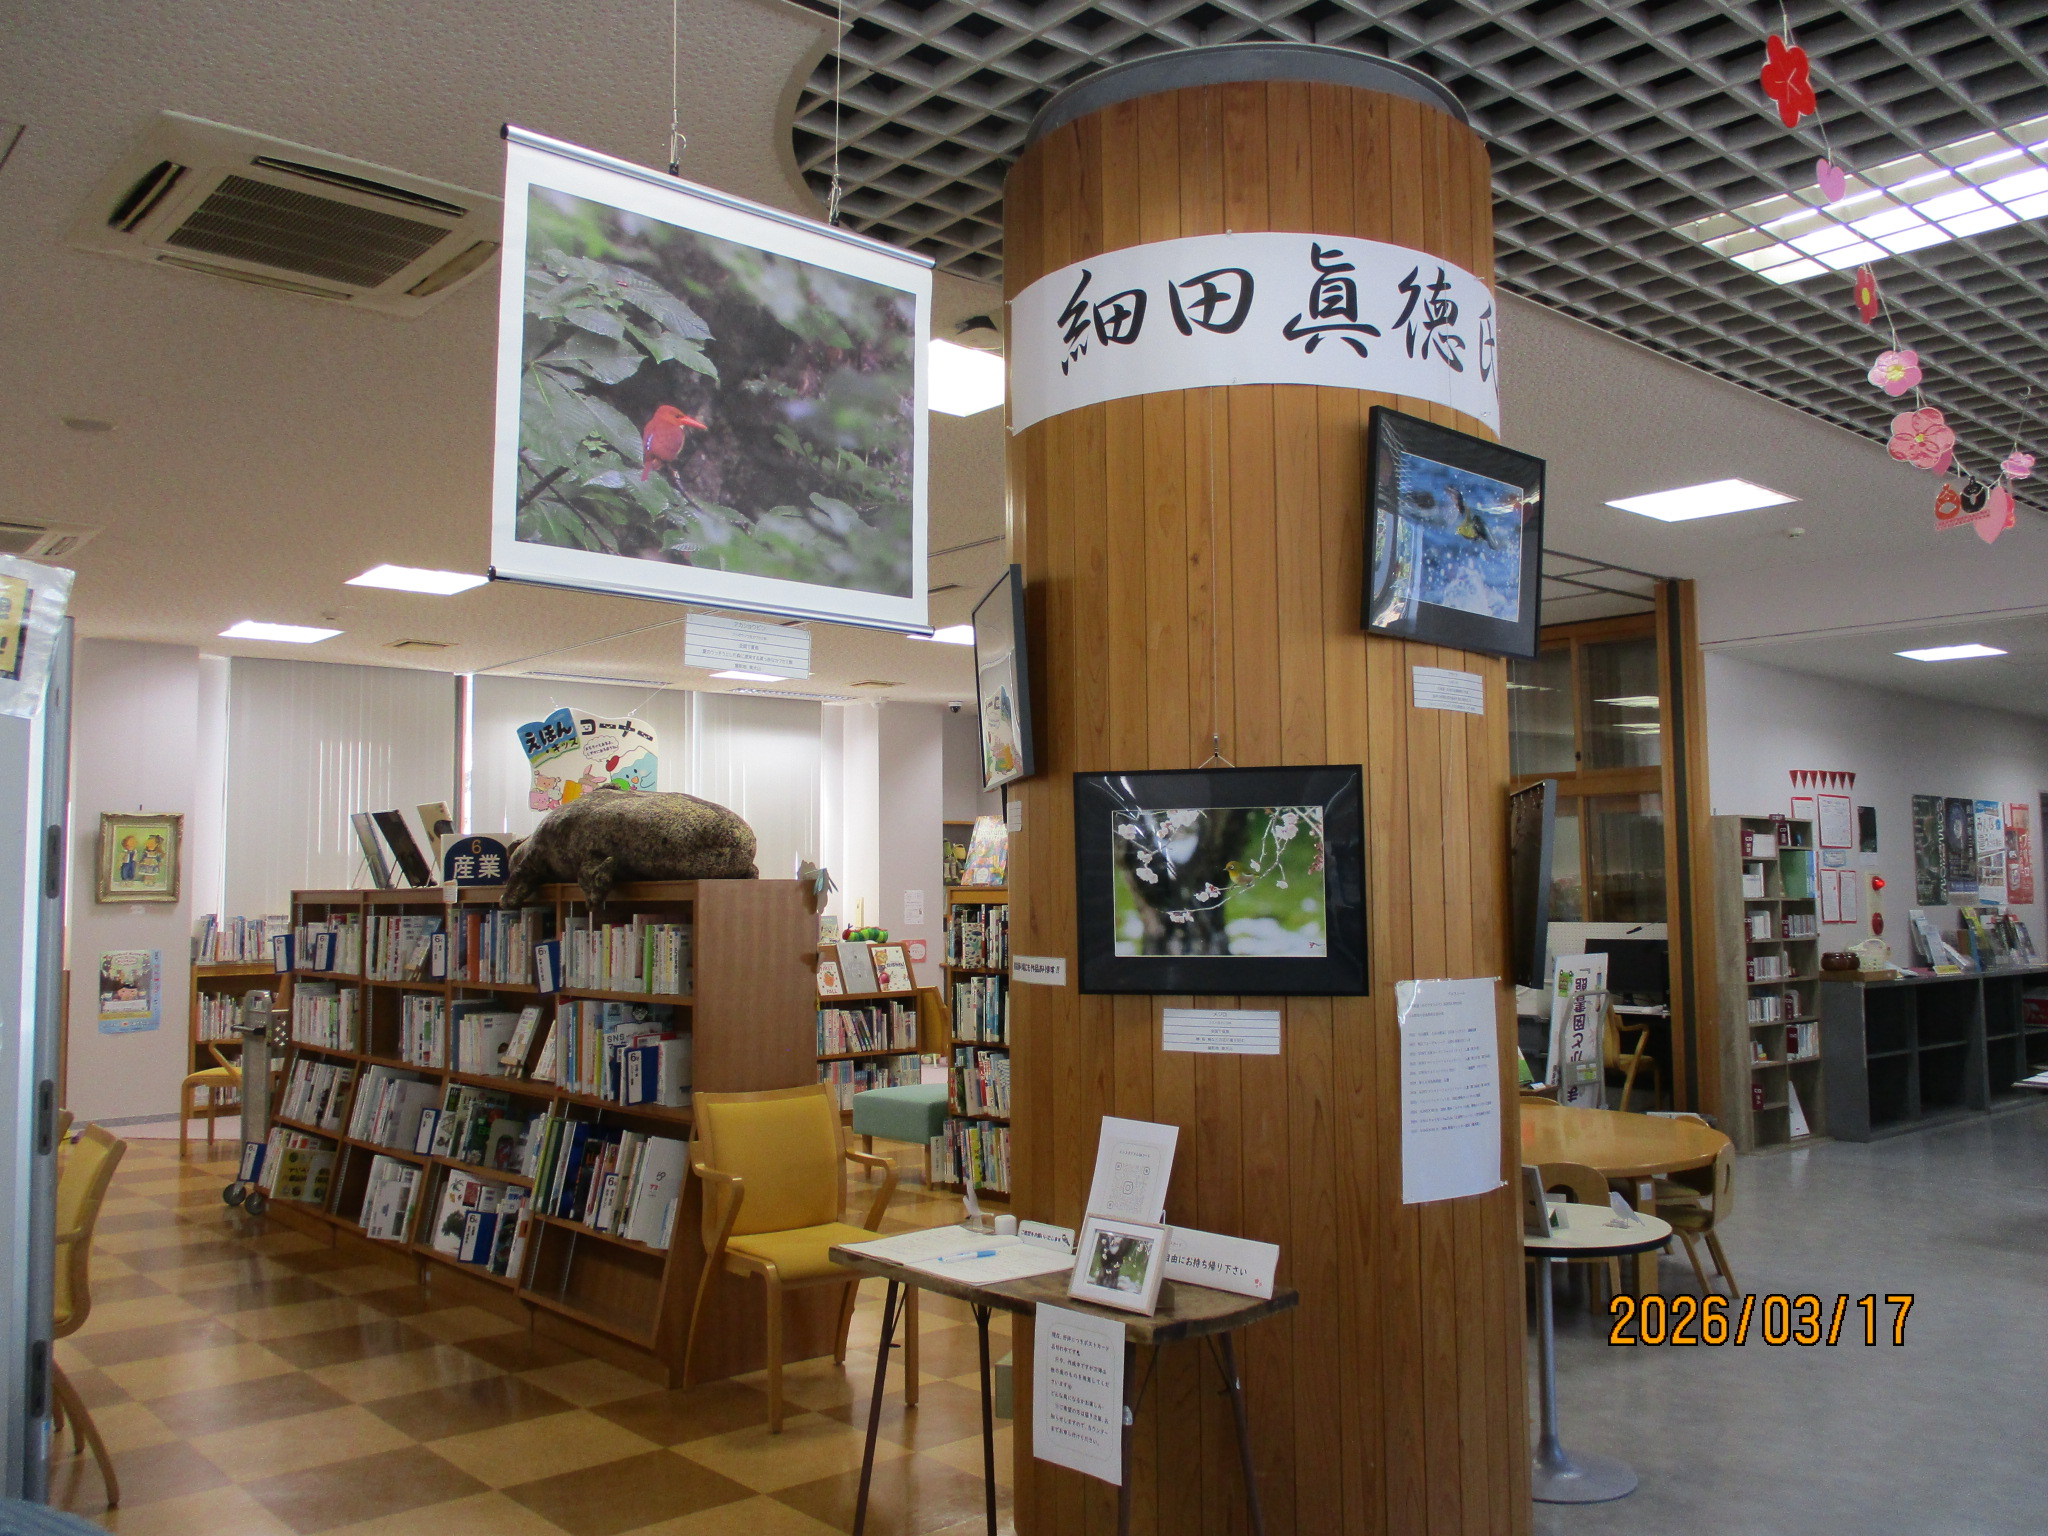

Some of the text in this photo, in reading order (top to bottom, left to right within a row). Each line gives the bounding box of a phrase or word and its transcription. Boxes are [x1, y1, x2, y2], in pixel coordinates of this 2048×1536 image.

[525, 721, 573, 754] えほん
[580, 718, 655, 742] コーナー
[471, 839, 482, 854] 6
[453, 854, 501, 879] 産業
